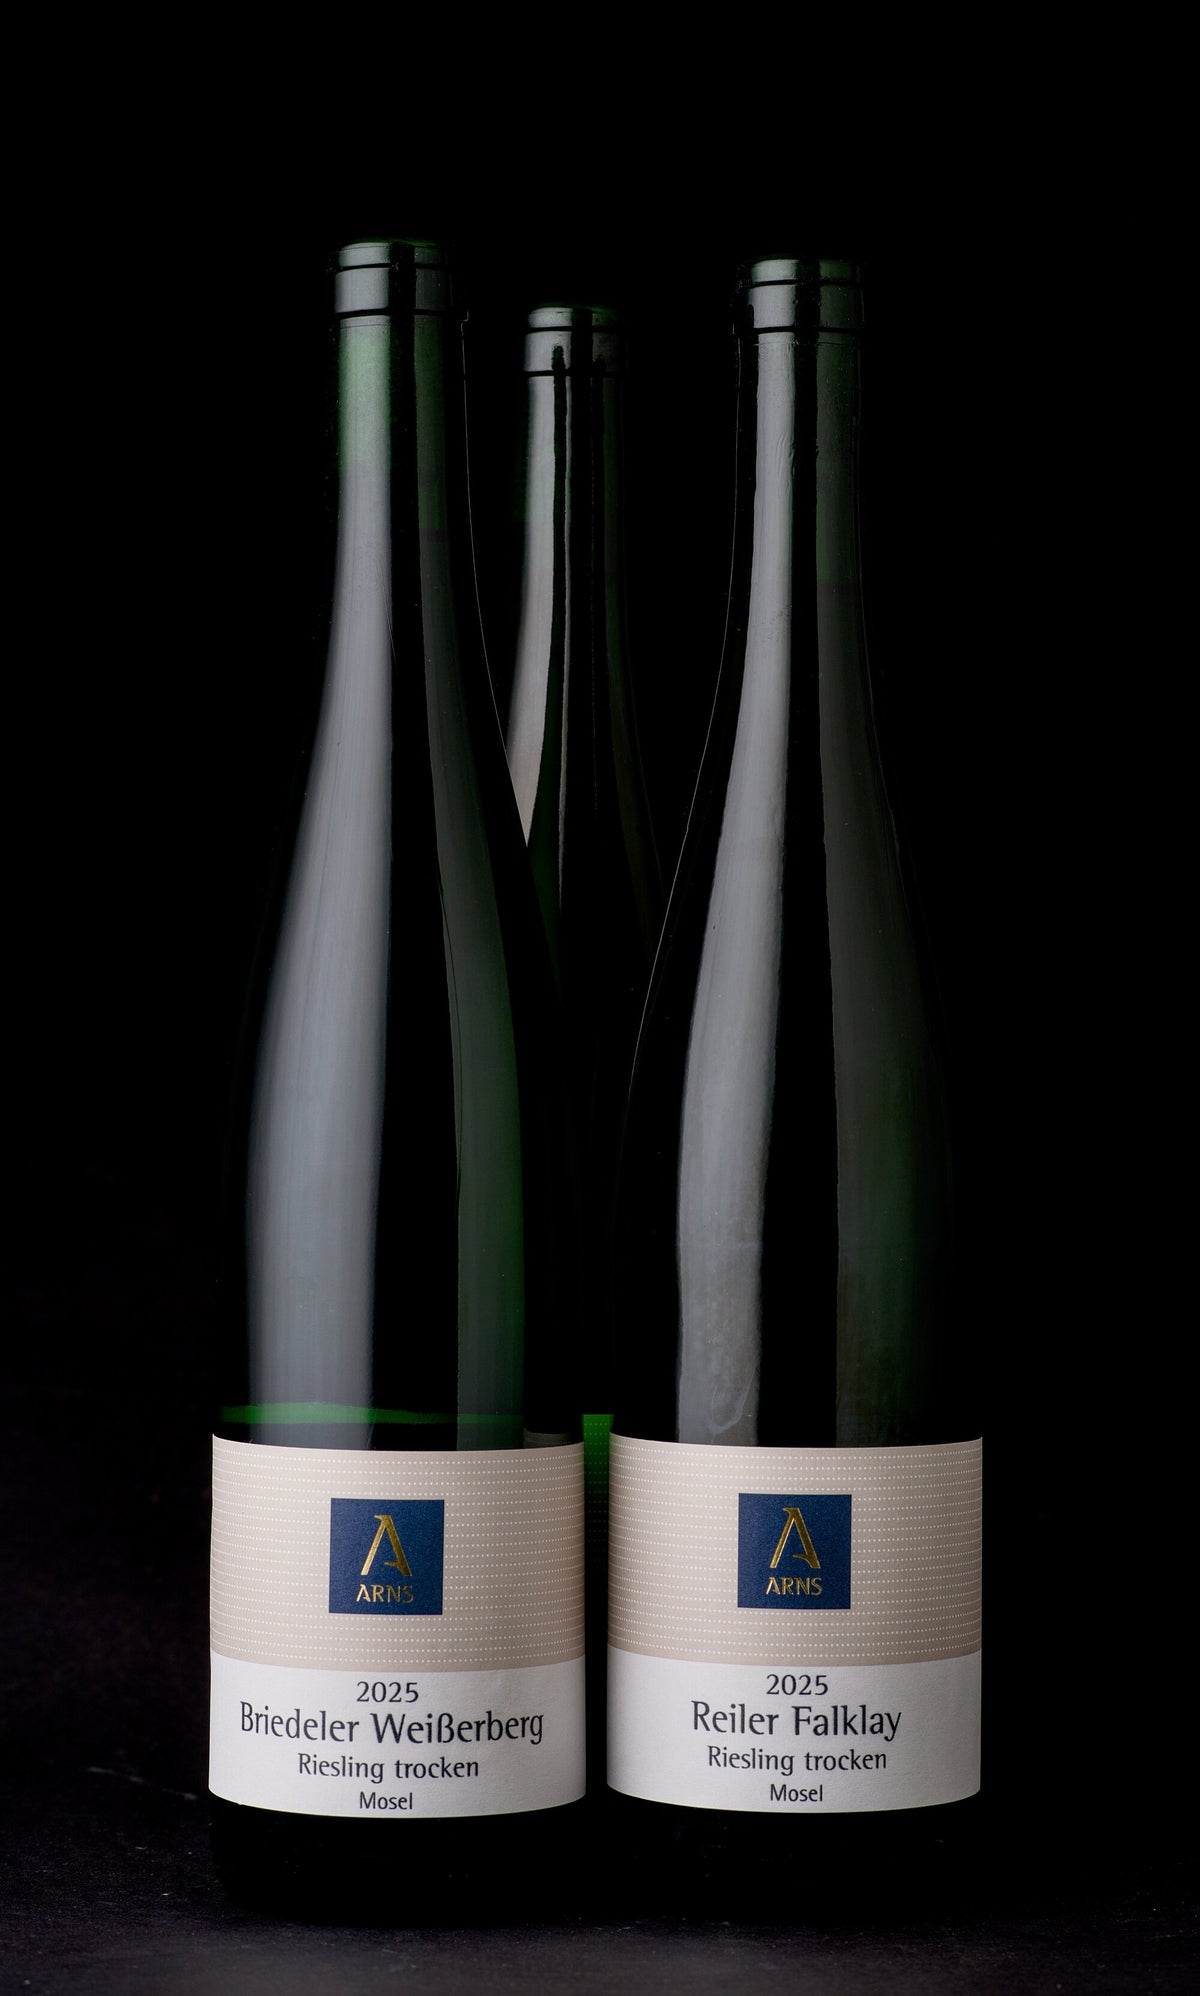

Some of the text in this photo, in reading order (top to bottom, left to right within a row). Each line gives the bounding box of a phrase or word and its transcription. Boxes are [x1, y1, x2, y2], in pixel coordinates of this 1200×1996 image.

[360, 1514, 412, 1576] A
[769, 1507, 821, 1569] A
[355, 1583, 414, 1603] ARNS
[765, 1576, 823, 1596] ARNS
[356, 1681, 419, 1703] 2025
[765, 1674, 829, 1696] 2025
[240, 1700, 544, 1745] Briedeler Weißerberg
[690, 1700, 902, 1742] Reiler Falklay
[298, 1752, 479, 1784] Riesling trocken
[707, 1745, 887, 1776] Riesling trocken
[359, 1791, 414, 1810] Mosel
[769, 1783, 824, 1803] Mosel
